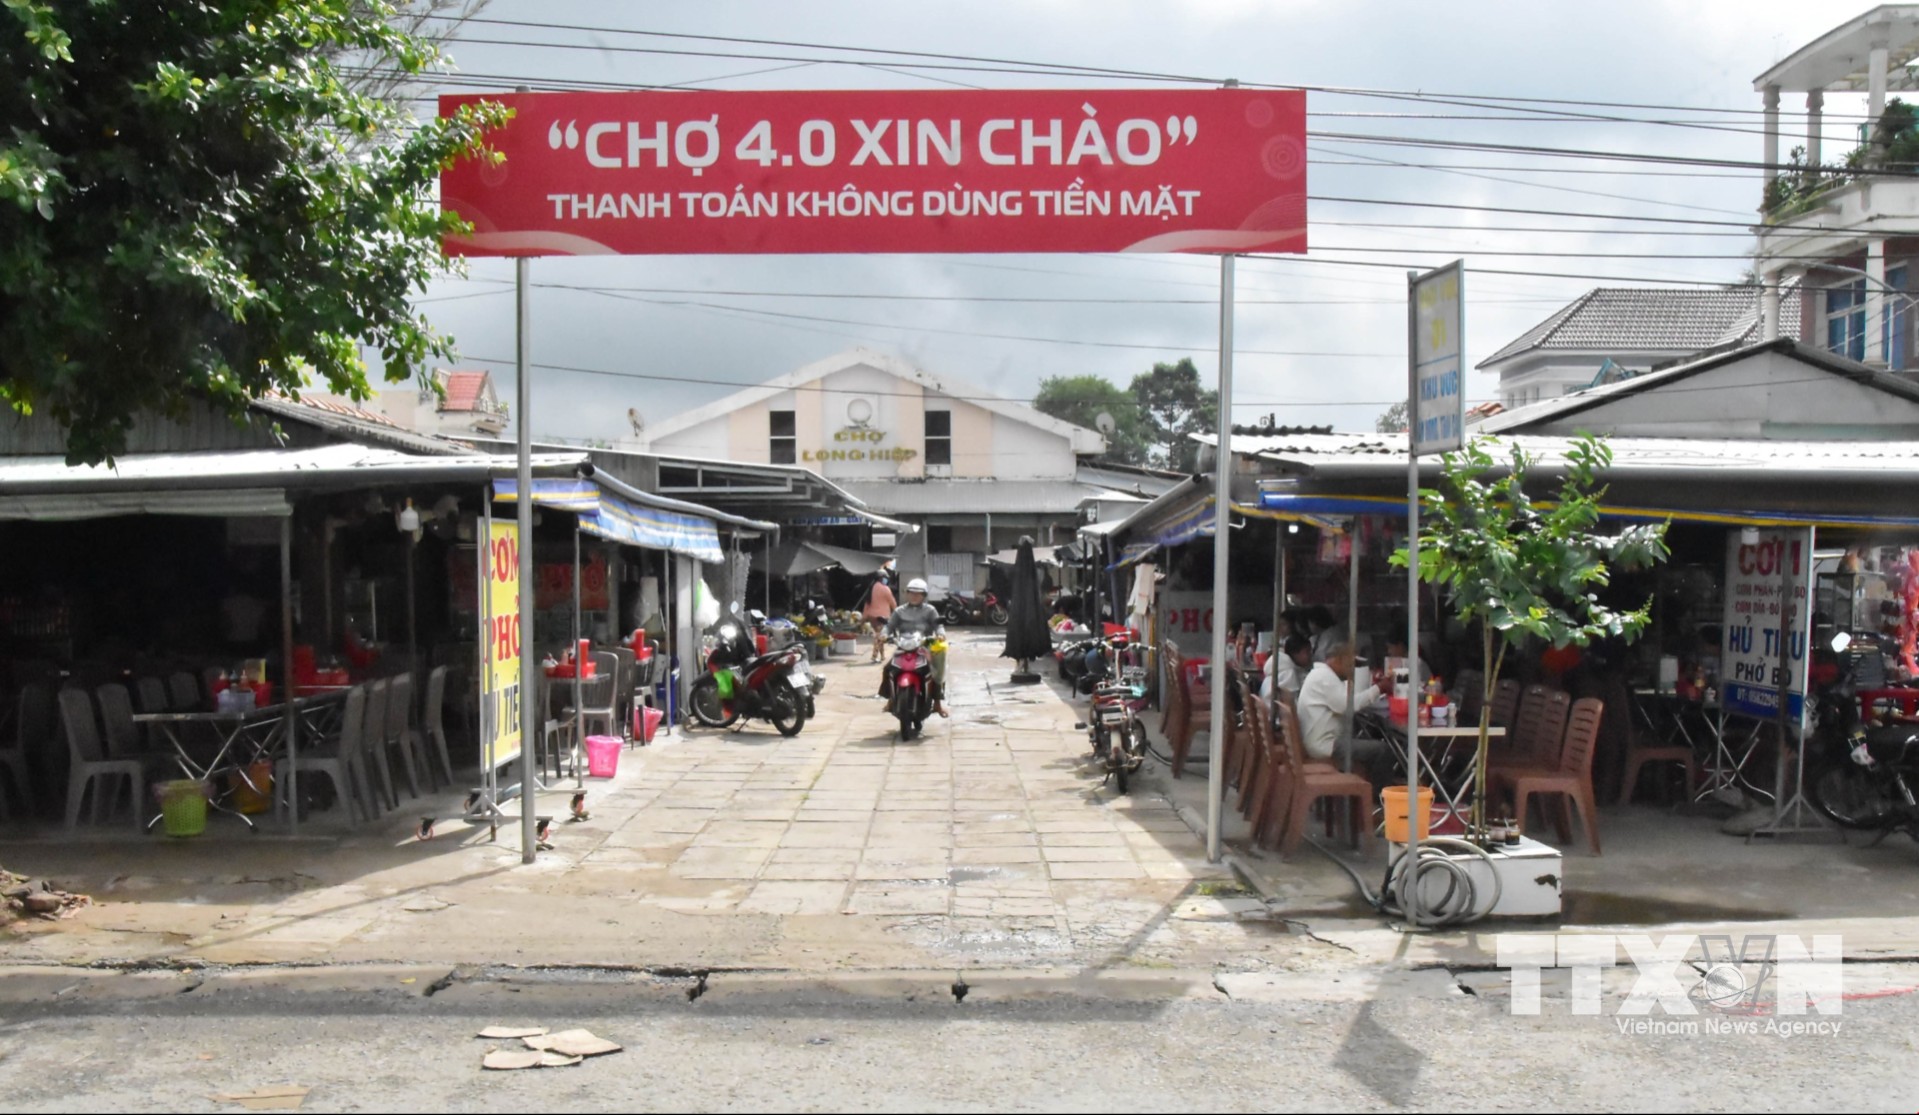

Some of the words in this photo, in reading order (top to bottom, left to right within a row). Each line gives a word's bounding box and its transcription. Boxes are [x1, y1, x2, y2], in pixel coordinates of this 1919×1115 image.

[548, 113, 720, 176] “CHỢ
[735, 120, 836, 166] 4.0
[850, 119, 962, 166] XIN
[978, 102, 1198, 166] CHÀO”
[547, 193, 671, 219] THANH
[679, 184, 778, 218] TOÁN
[787, 183, 914, 217] KHÔNG
[922, 182, 1023, 217] DÙNG
[1030, 176, 1111, 216] TIỀN
[1120, 185, 1201, 221] MẶT
[802, 449, 864, 461] LONG
[1738, 535, 1802, 576] CƠM
[1728, 614, 1753, 654] HỦ
[1762, 618, 1804, 661] TIU
[1735, 656, 1766, 683] PHỞ
